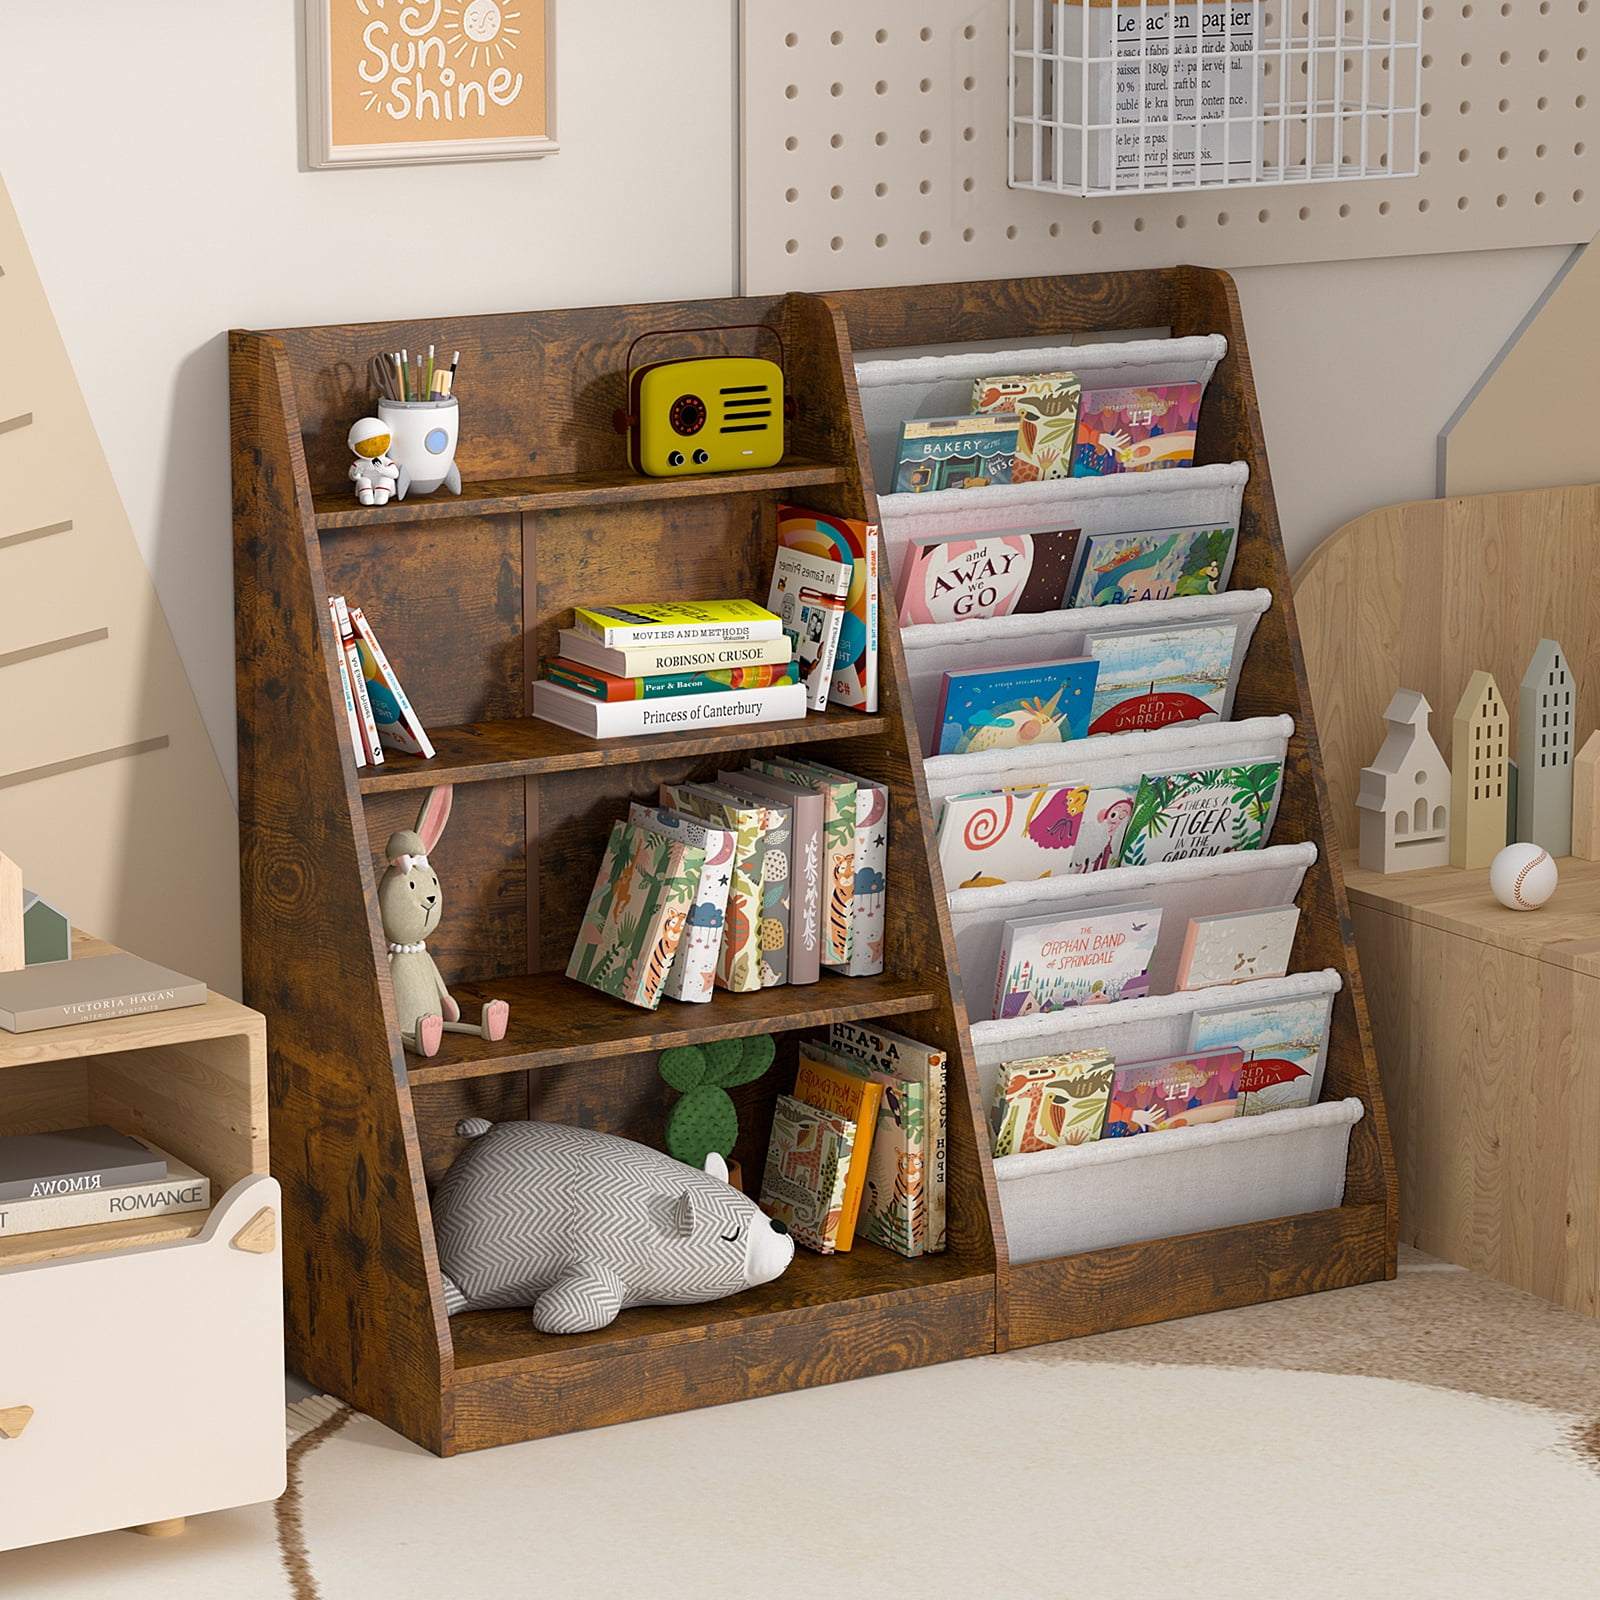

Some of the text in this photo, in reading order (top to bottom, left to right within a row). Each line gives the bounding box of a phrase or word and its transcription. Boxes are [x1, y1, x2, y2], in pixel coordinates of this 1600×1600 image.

[1117, 14, 1135, 32] Le
[1202, 8, 1251, 32] papier
[358, 20, 446, 83] Sun
[1191, 41, 1214, 54] prtir
[1187, 60, 1213, 75] paier
[1189, 77, 1212, 89] blnc
[1115, 98, 1139, 111] oublé
[1174, 95, 1195, 107] brun
[1117, 152, 1136, 166] peut
[1160, 148, 1196, 164] plsieurs
[1128, 409, 1153, 427] E.T.
[923, 440, 982, 454] BAKERY
[965, 546, 987, 562] and
[930, 552, 1021, 600] AWAY
[967, 581, 985, 593] we
[953, 587, 997, 615] GO
[632, 627, 751, 641] MOVIES AND METHODS
[656, 648, 764, 668] ROBINSON CRUSOE
[645, 683, 666, 692] Pear
[676, 680, 703, 689] Bacon
[643, 701, 763, 725] Princess of Canterbury
[1139, 701, 1165, 714] RED
[1115, 709, 1185, 728] UMBRELLA
[1220, 796, 1229, 806] A
[1170, 807, 1232, 838] TIGER
[1174, 835, 1210, 850] IN THE
[1080, 926, 1093, 935] THE
[1040, 932, 1126, 958] ORPHAN BAND
[1046, 950, 1116, 970] of SPRINGDALE
[63, 990, 176, 1016] VICTORIA HAGAN
[80, 1011, 116, 1022] INTERIOR
[1238, 1072, 1281, 1089] BRELLA
[1164, 1082, 1191, 1101] E.T.
[109, 1186, 203, 1213] ROMANCE
